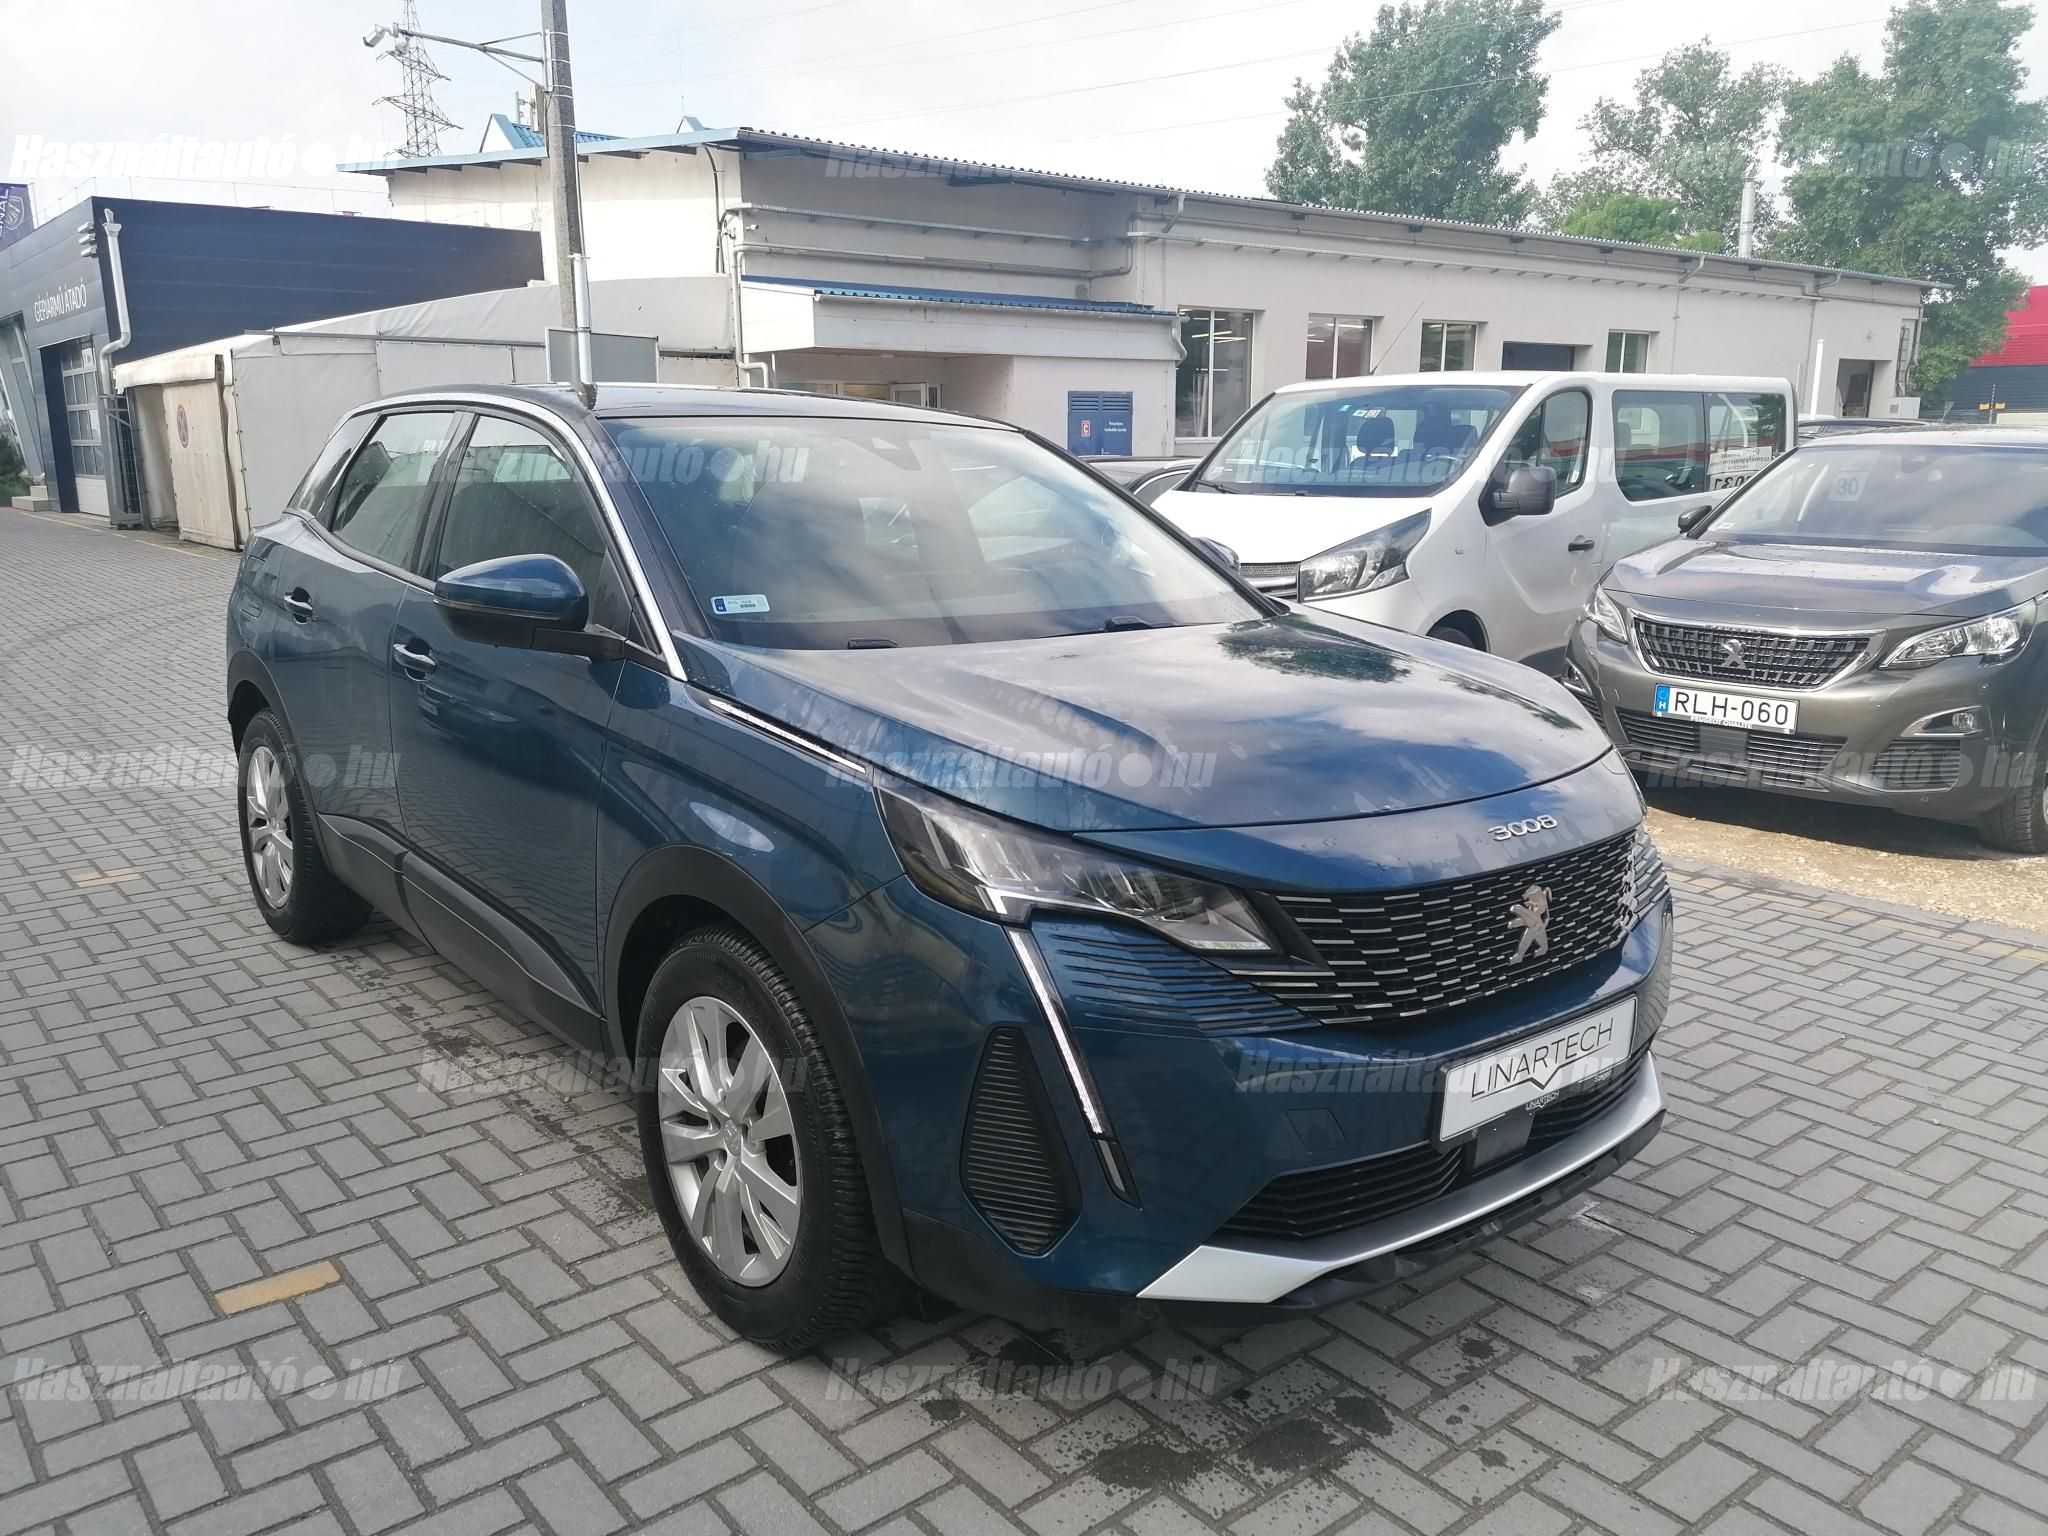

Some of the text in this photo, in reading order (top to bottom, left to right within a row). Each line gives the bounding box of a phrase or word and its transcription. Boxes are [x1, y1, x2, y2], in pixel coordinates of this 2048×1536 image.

[1837, 477, 1859, 496] 30
[1658, 691, 1788, 725] H RLH-060
[1487, 814, 1558, 841] 3008
[1471, 1017, 1614, 1098] LINARTECH
